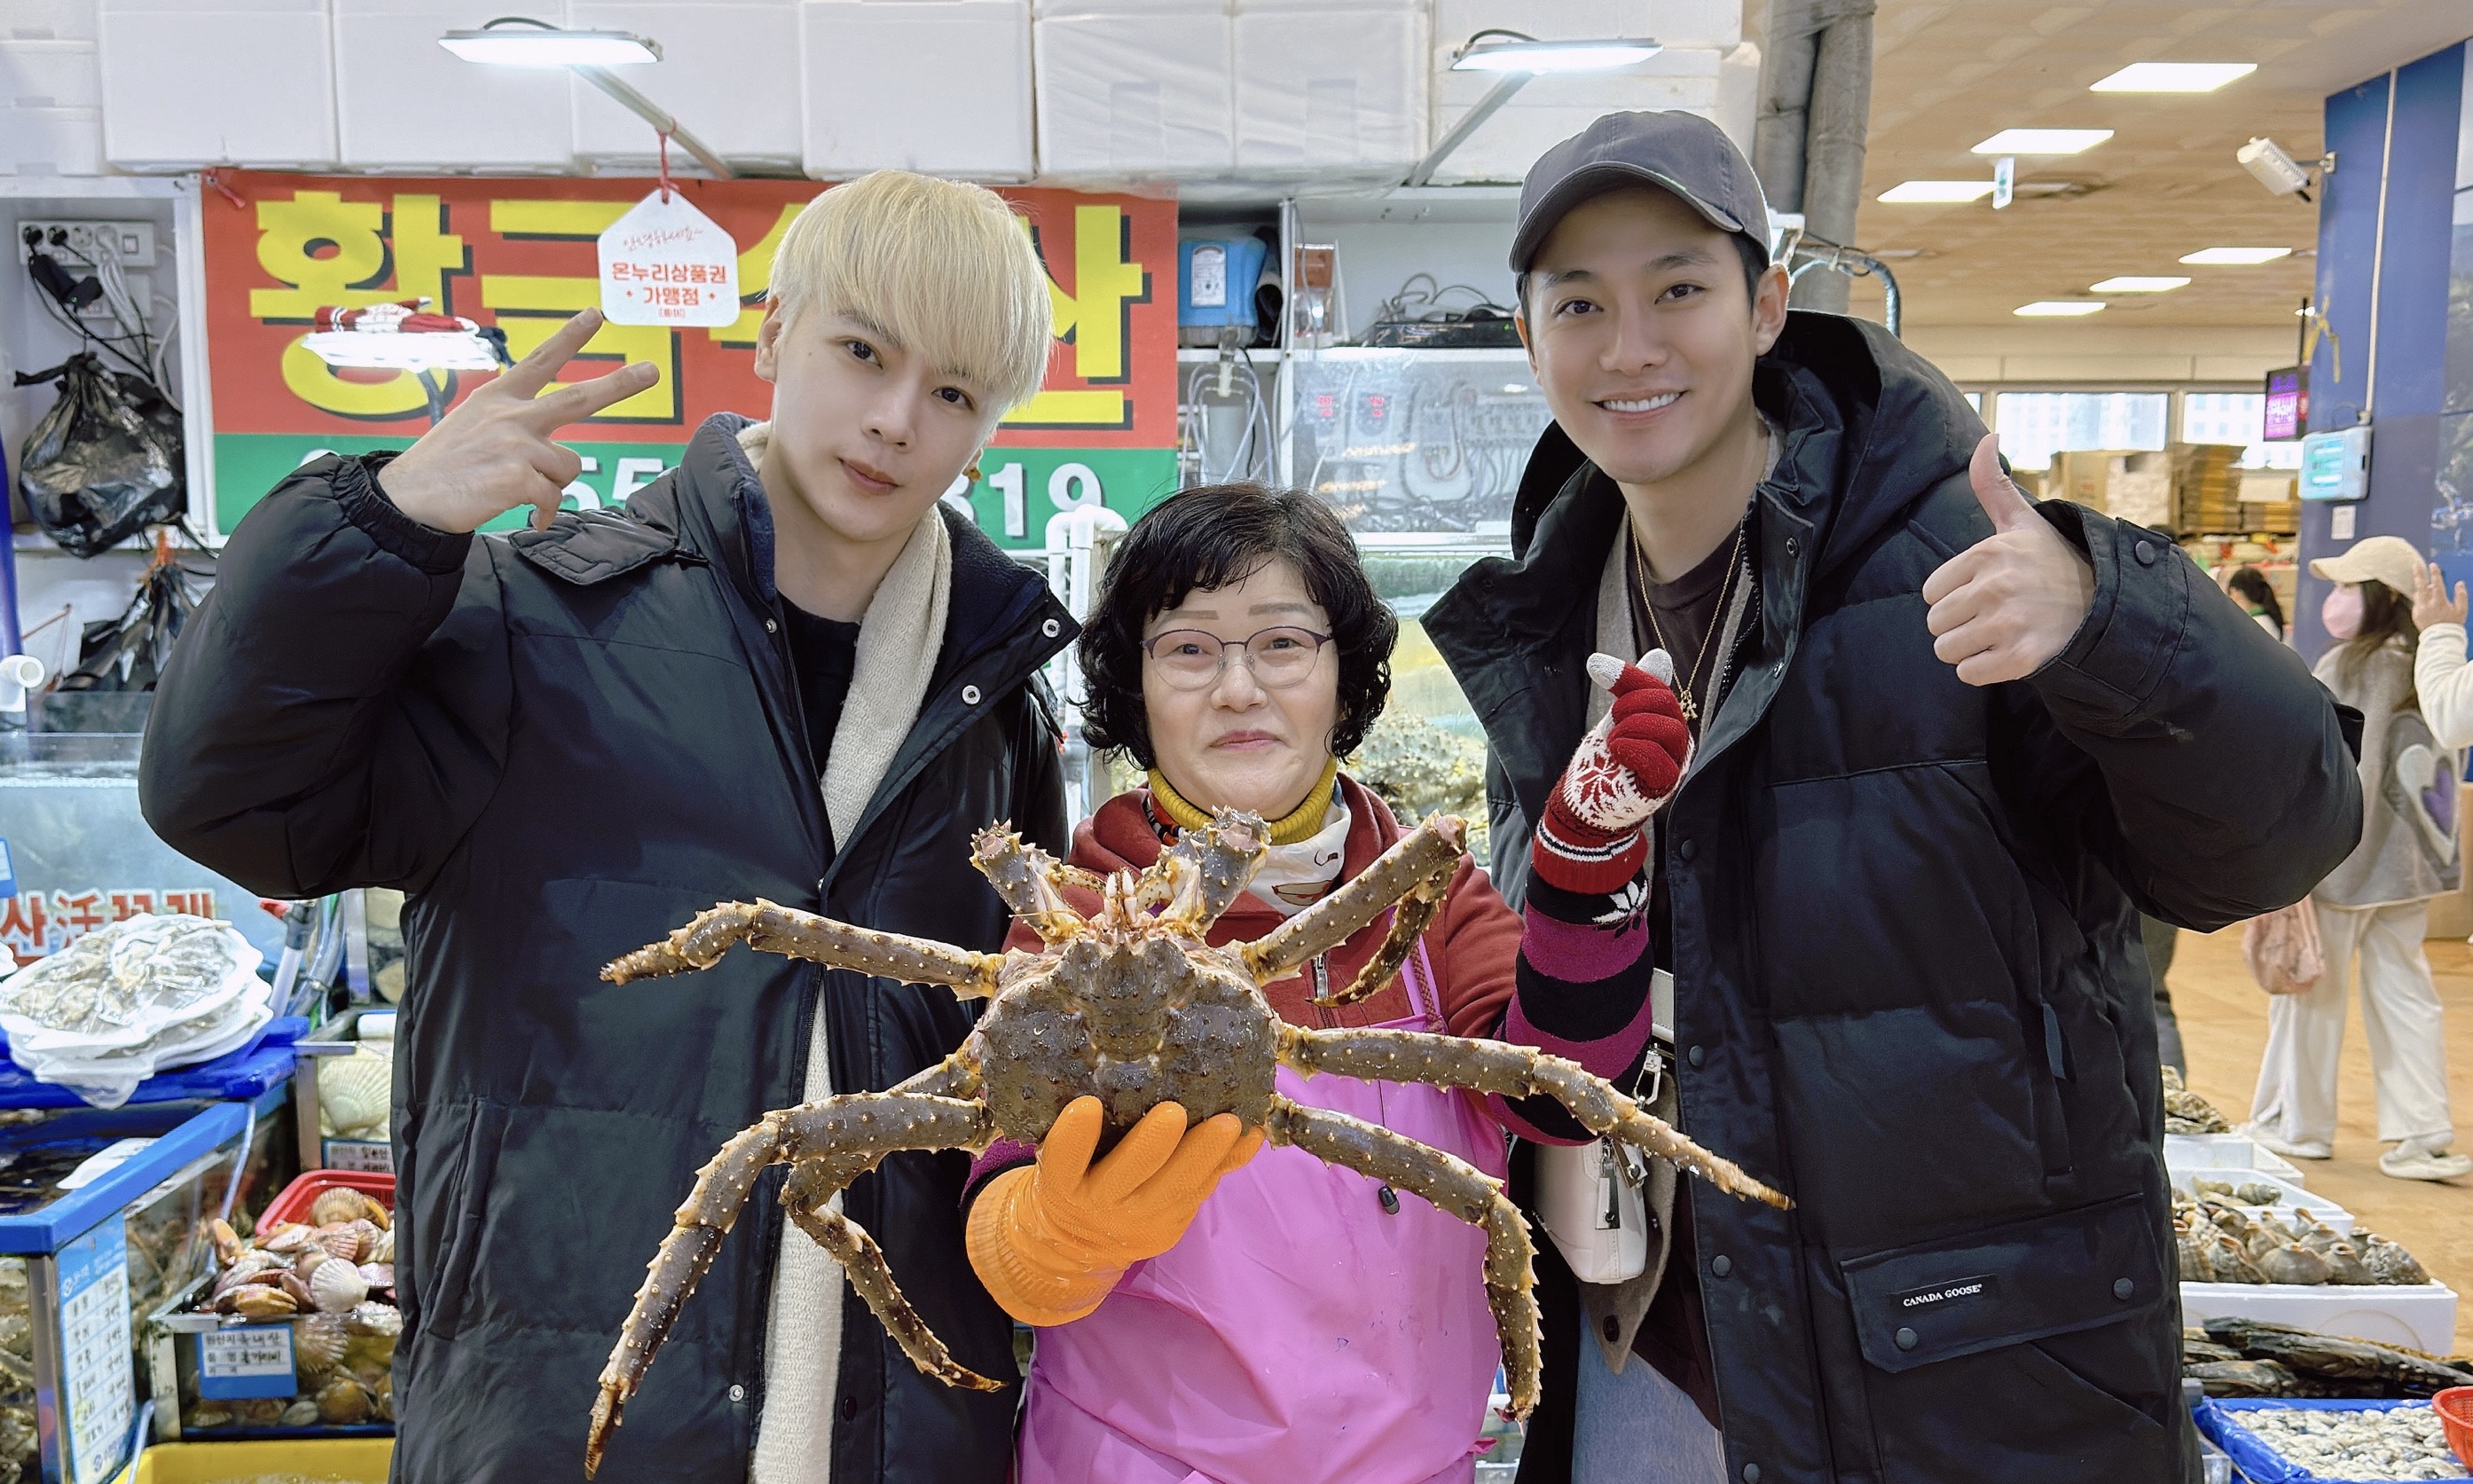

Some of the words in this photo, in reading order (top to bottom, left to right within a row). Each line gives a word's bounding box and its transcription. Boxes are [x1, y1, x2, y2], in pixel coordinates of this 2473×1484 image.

[612, 263, 727, 284] 온누리상품권
[643, 287, 700, 306] 가맹점
[1903, 1292, 1944, 1307] CANADA
